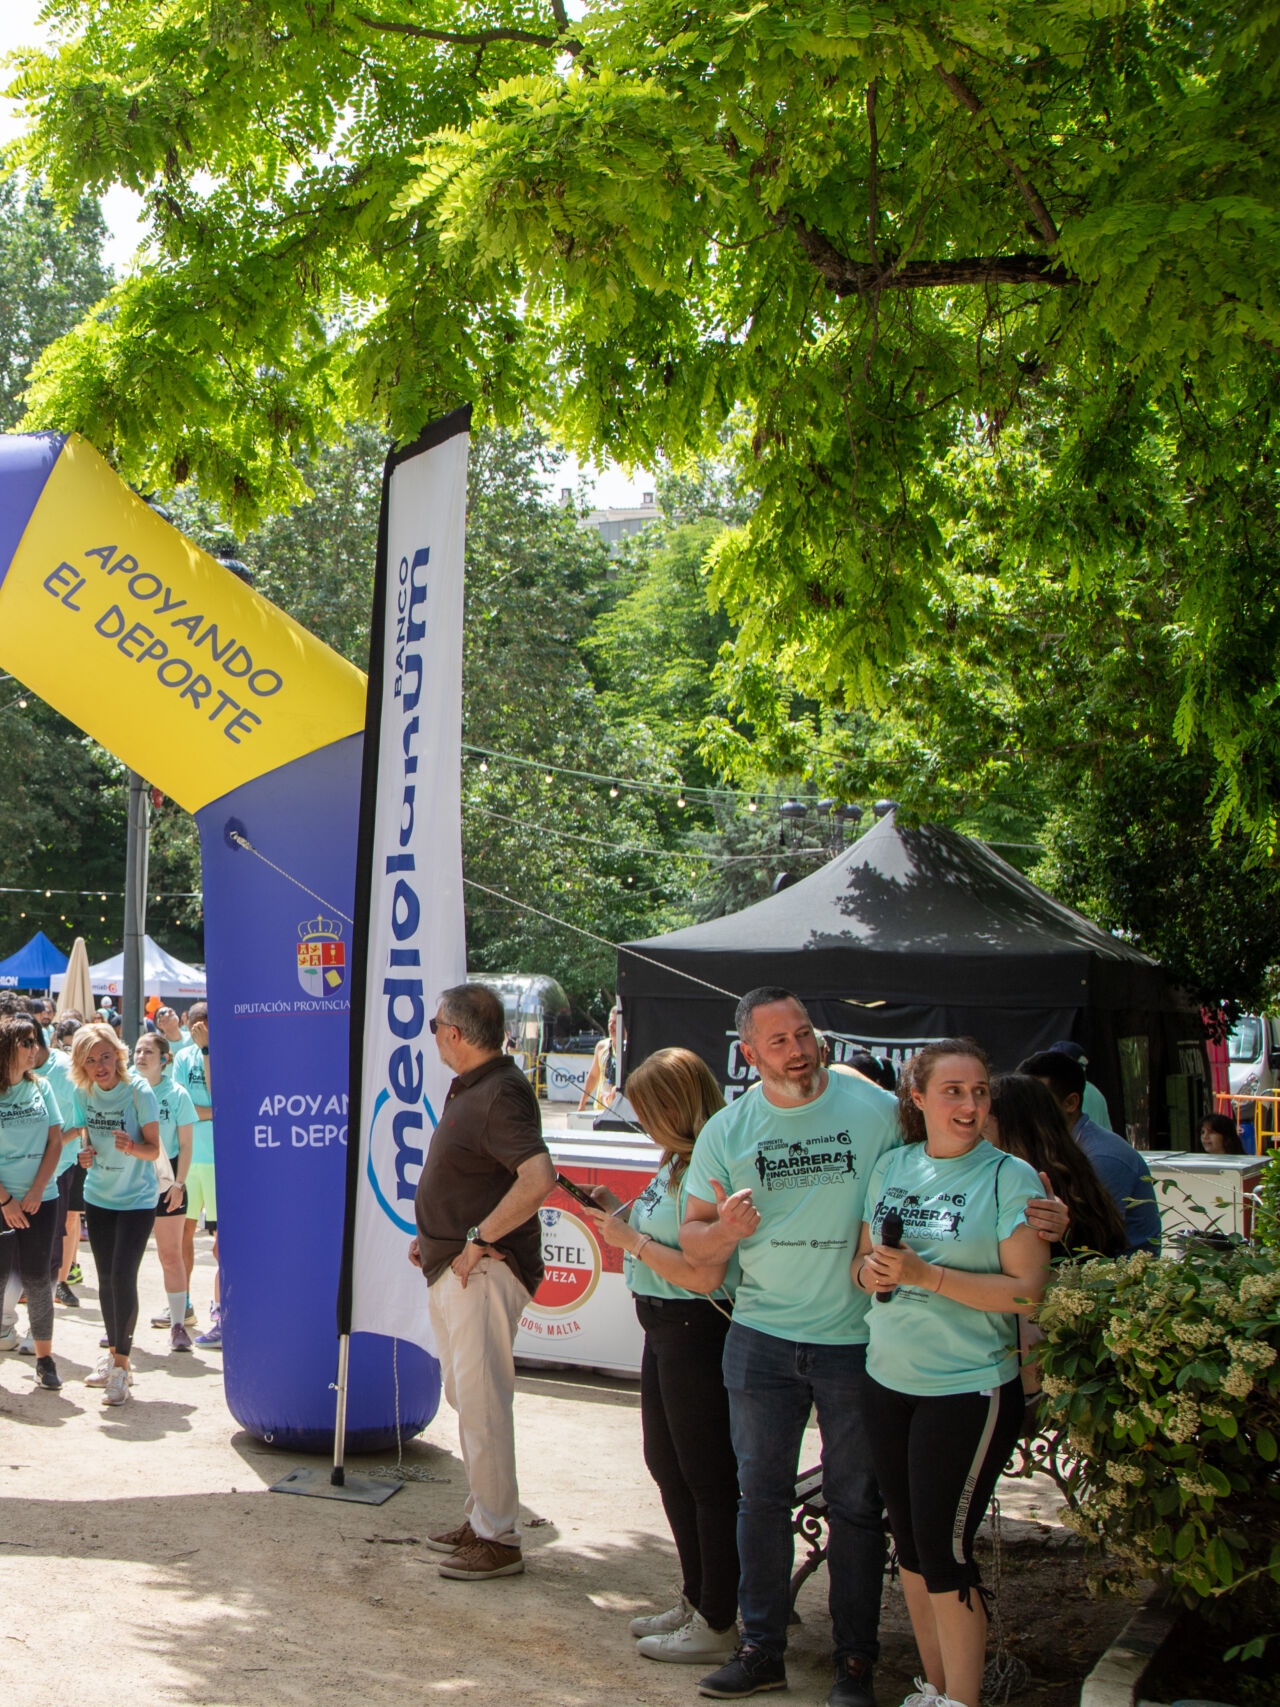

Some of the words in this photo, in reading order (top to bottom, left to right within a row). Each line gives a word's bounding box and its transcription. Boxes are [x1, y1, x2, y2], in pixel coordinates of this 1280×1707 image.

[84, 545, 283, 697] APOYANDO
[393, 556, 409, 699] BANCO
[43, 561, 86, 612] EL
[94, 604, 262, 744] DEPORTE
[234, 1001, 291, 1014] DIPUTACIÓN
[294, 1000, 351, 1011] PROVINCIA
[254, 1125, 281, 1148] EL
[806, 1134, 835, 1146] amiab
[766, 1152, 843, 1171] CARRERA
[770, 1165, 822, 1179] INCLUSIVA
[772, 1172, 845, 1191] CUENCA
[880, 1205, 953, 1221] CARRERA
[876, 1226, 944, 1241] CENCA
[543, 1244, 586, 1265] STEL
[544, 1270, 577, 1284] VEZA
[546, 1320, 581, 1336] MALTA
[960, 1489, 972, 1505] LATE
[956, 1505, 968, 1517] TOO
[953, 1518, 964, 1539] NEVER
